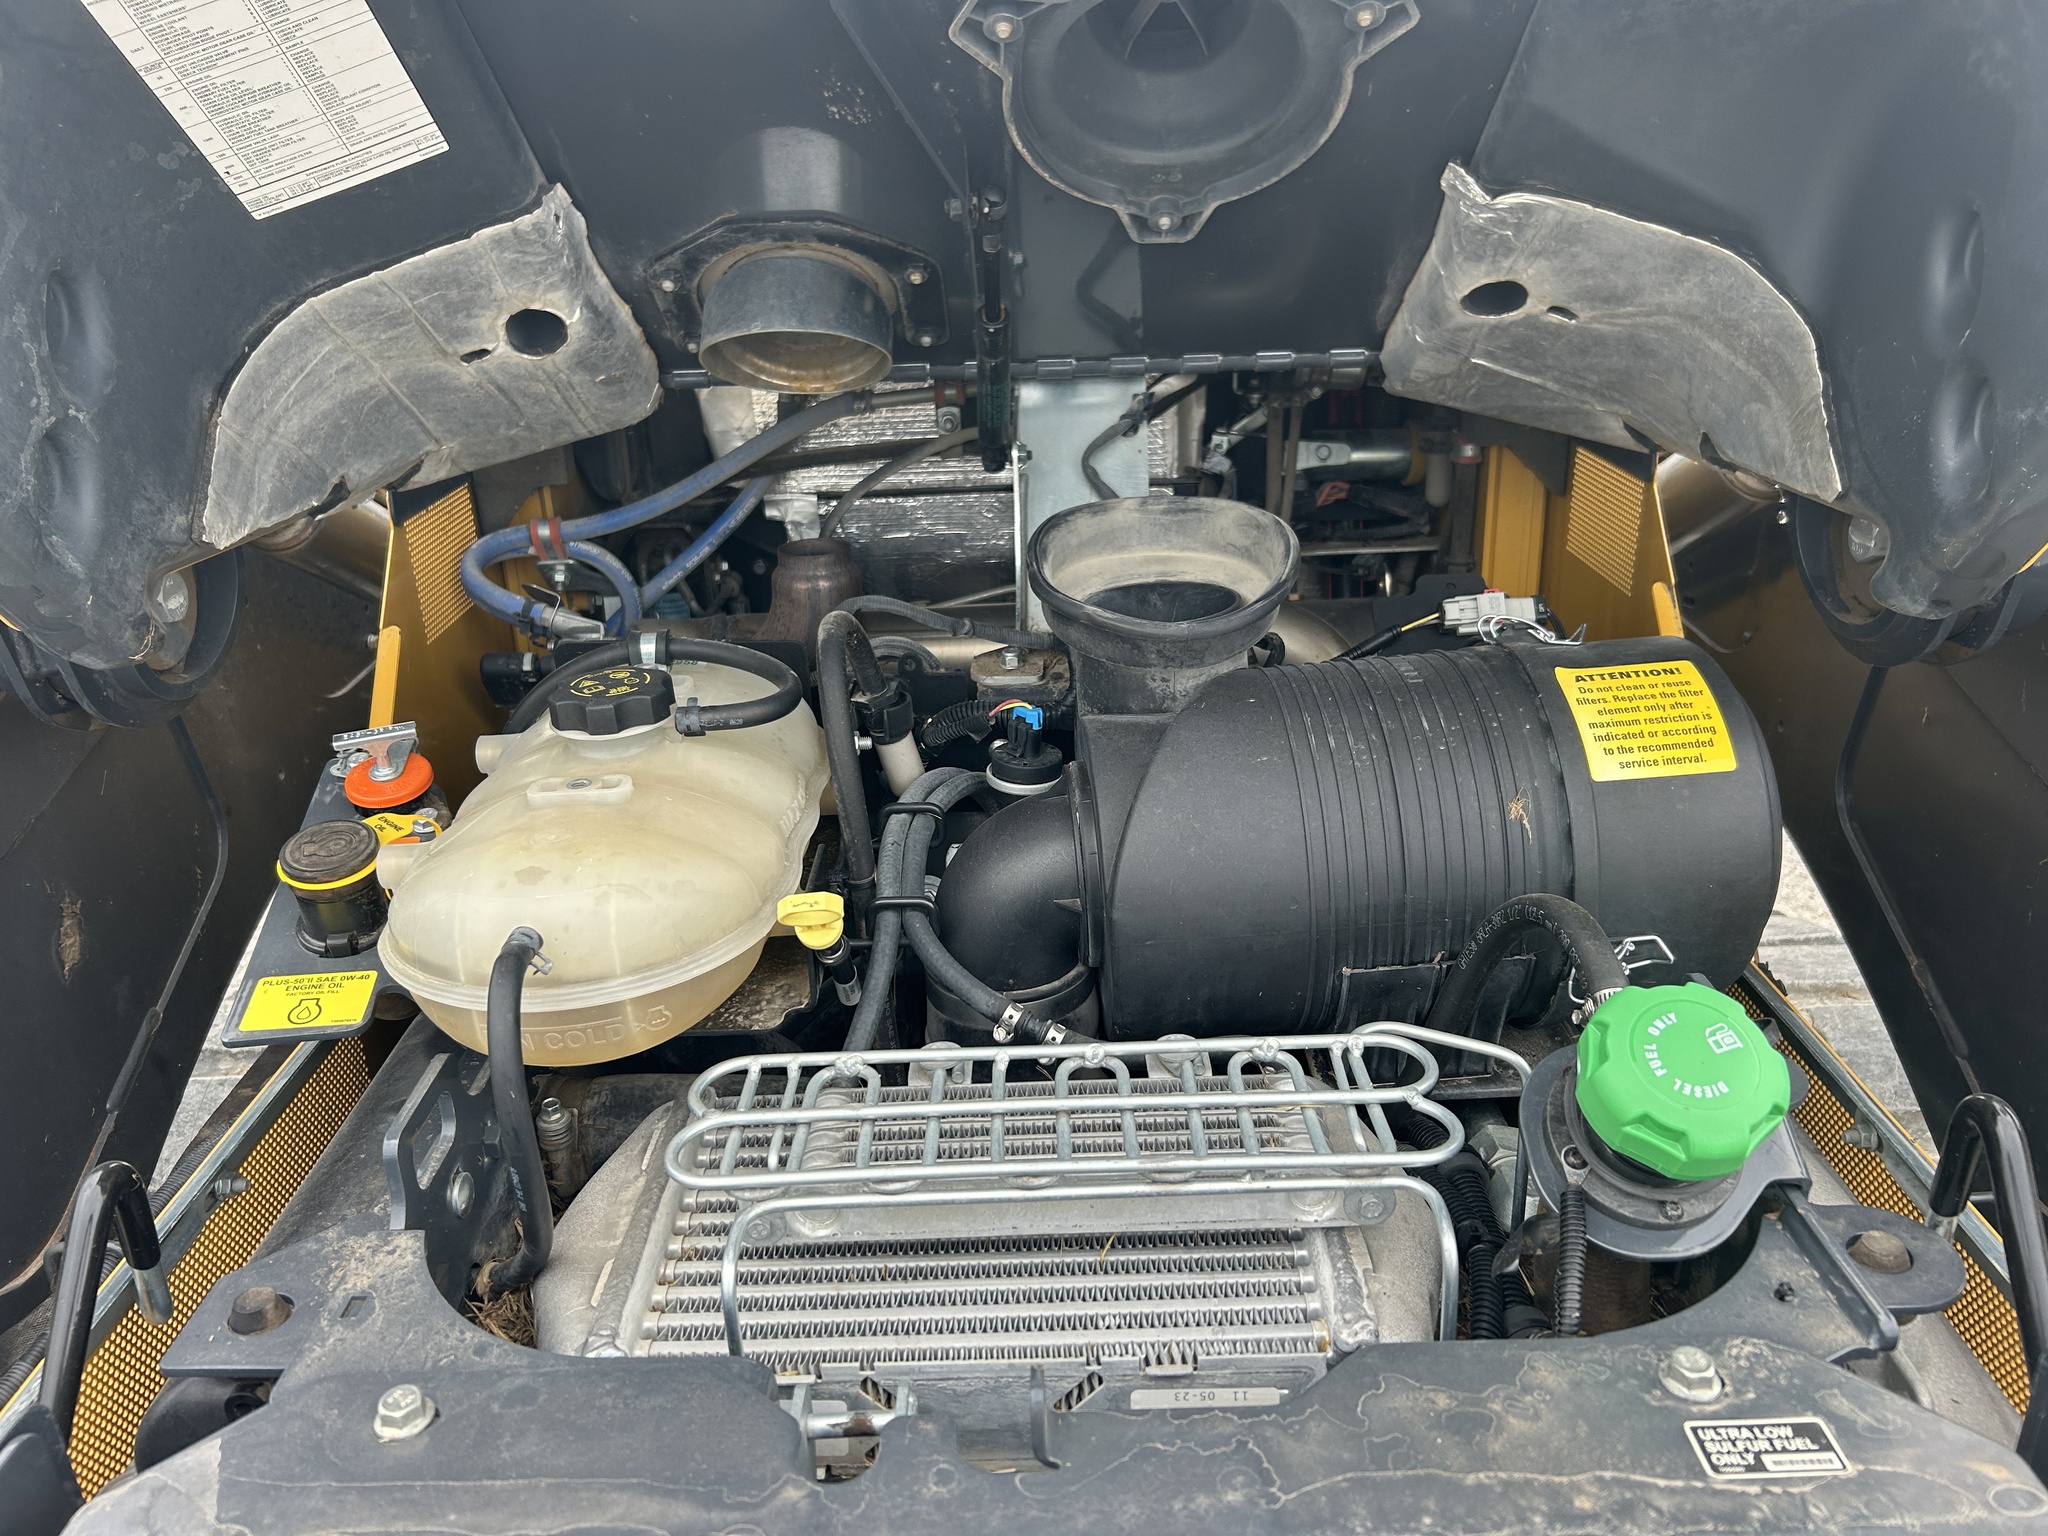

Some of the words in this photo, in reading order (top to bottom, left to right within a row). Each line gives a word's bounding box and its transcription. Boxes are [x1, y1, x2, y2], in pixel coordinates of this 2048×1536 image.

[1575, 668, 1682, 682] ATTENTION!
[1616, 683, 1645, 691] clean
[1662, 679, 1691, 687] reuse
[1576, 697, 1610, 706] filters.
[1613, 692, 1657, 704] Replace
[1659, 691, 1676, 699] the
[1679, 688, 1704, 697] filter
[1597, 705, 1641, 716] element
[1644, 704, 1666, 714] only
[1670, 701, 1693, 710] after
[1588, 718, 1641, 729] maximum
[1644, 713, 1700, 725] restriction
[1702, 711, 1712, 720] is
[1593, 729, 1644, 742] indicated
[1662, 724, 1716, 737] according
[1603, 746, 1614, 756] to
[1617, 744, 1634, 754] the
[1638, 738, 1714, 753] recommended
[1619, 757, 1659, 770] service
[1662, 753, 1707, 765] interval.
[1647, 1012, 1678, 1036] ONLY
[544, 1024, 628, 1050] COLD
[1644, 1043, 1668, 1077] FUEL
[1673, 1078, 1730, 1098] DIESEL
[1174, 1391, 1216, 1402] 05-23
[1696, 1427, 1752, 1441] ULTRA
[1752, 1425, 1794, 1440] LOW
[1703, 1439, 1773, 1454] SULFUR
[1772, 1436, 1820, 1450] FUEL
[1709, 1453, 1756, 1466] ONLY
